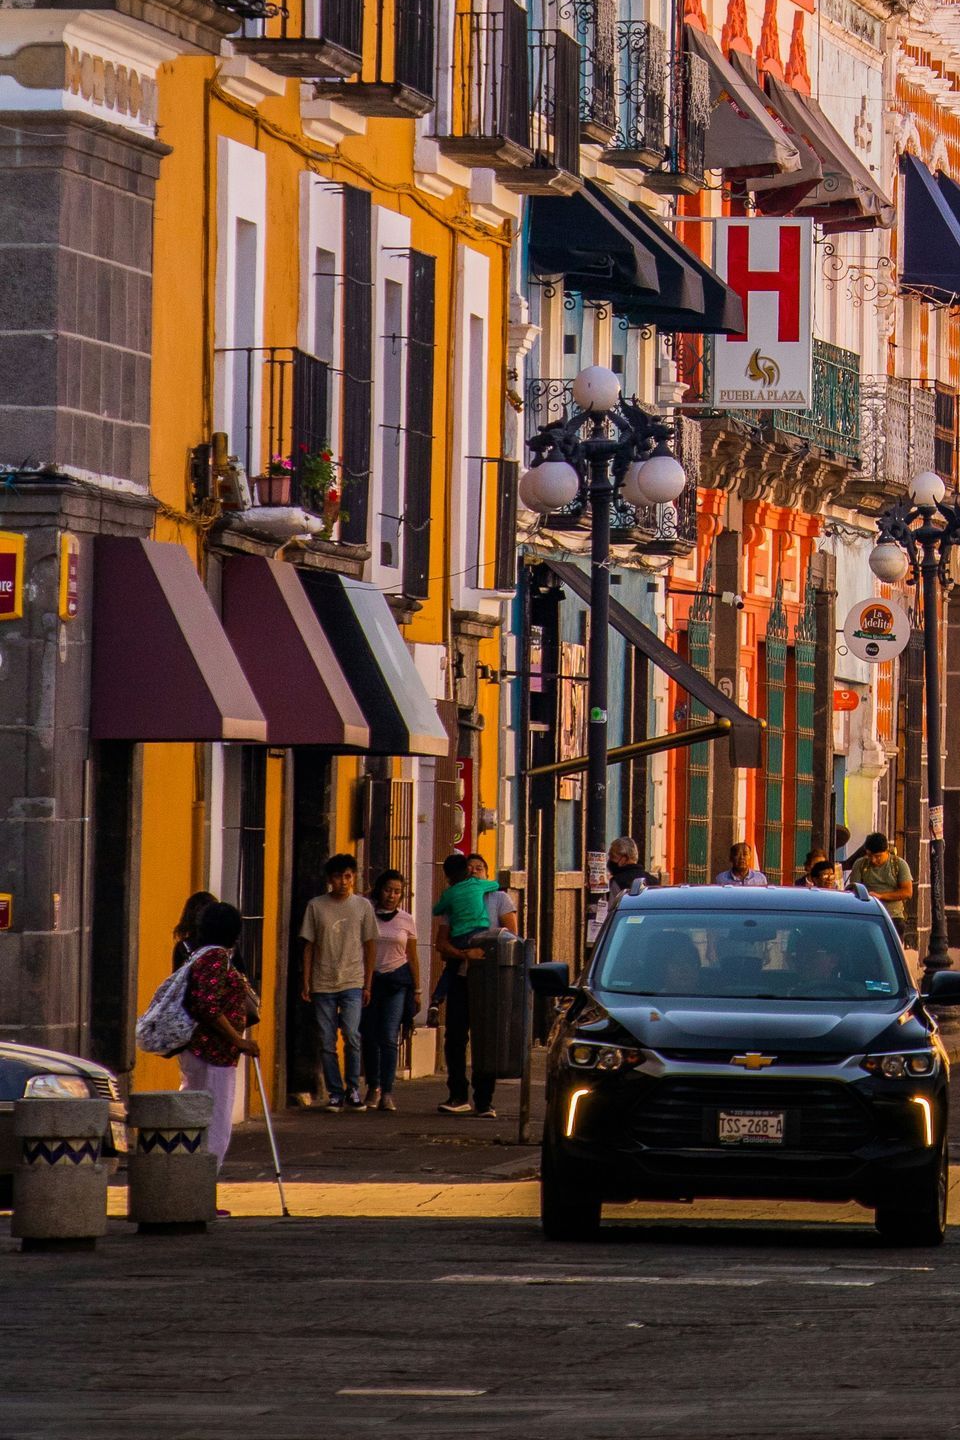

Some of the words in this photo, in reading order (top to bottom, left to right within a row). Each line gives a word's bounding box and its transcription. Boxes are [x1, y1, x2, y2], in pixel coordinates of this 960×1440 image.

[726, 226, 800, 342] H
[720, 389, 765, 401] PUEBLA
[767, 389, 805, 401] PLAZA
[873, 609, 882, 618] La
[862, 617, 892, 629] Adelita
[720, 1118, 782, 1134] TSS-268-A
